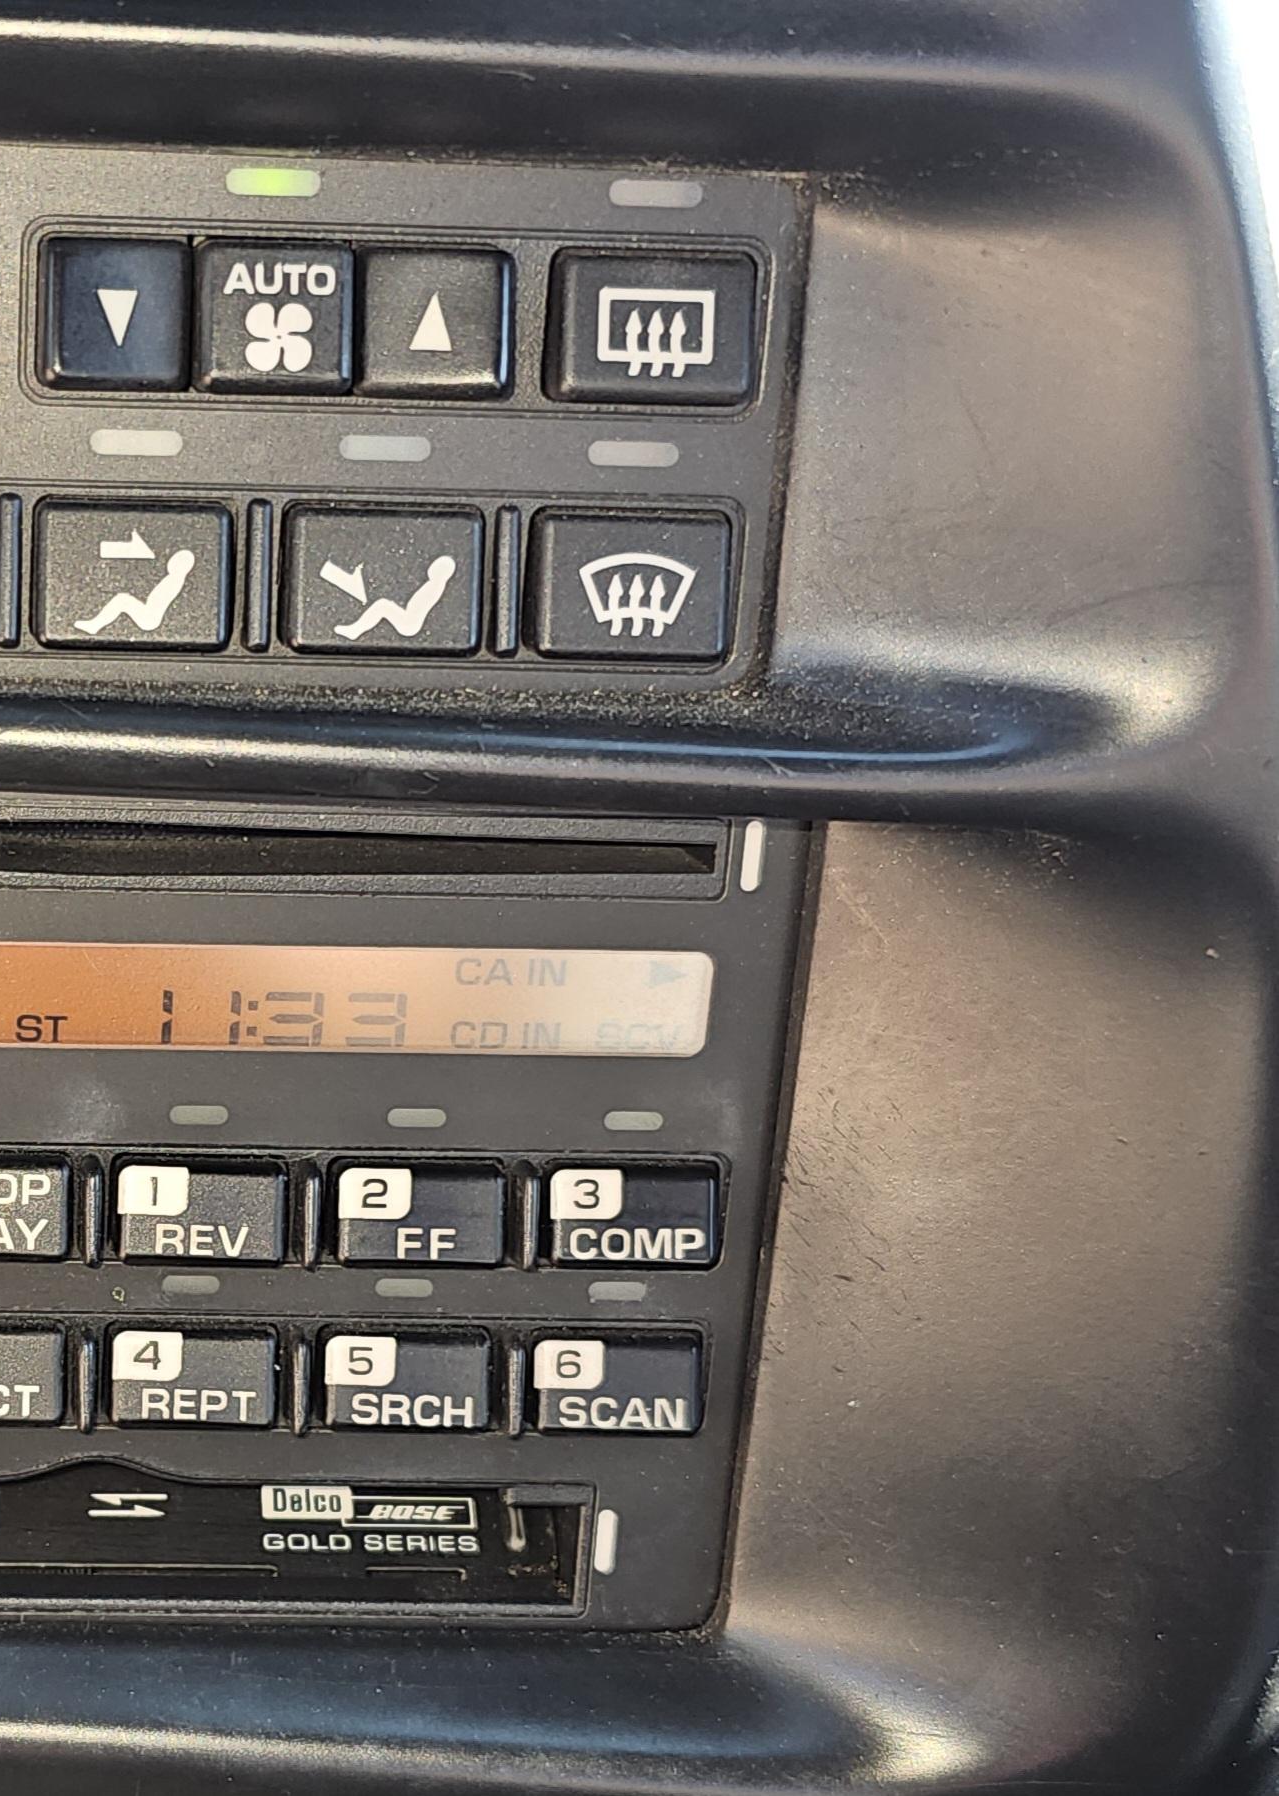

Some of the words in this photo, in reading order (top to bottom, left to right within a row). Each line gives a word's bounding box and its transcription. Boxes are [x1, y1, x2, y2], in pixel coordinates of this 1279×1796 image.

[223, 261, 336, 296] AUTO
[455, 958, 513, 986] CA
[528, 958, 568, 987] IN
[15, 1014, 69, 1043] ST
[161, 990, 408, 1047] 11:33
[450, 1021, 509, 1049] CD
[521, 1022, 562, 1050] IN
[149, 1175, 160, 1207] 1
[360, 1177, 390, 1209] 2
[572, 1178, 602, 1210] 3
[154, 1223, 249, 1257] REV
[396, 1227, 456, 1260] FF
[569, 1227, 707, 1261] COMP
[132, 1339, 162, 1371] 4
[347, 1345, 375, 1376] 5
[555, 1349, 583, 1380] 6
[140, 1388, 257, 1422] REPT
[350, 1393, 475, 1428] SRCH
[559, 1396, 687, 1430] SCAN
[272, 1487, 343, 1513] Delco
[356, 1504, 466, 1521] BOSE
[262, 1533, 353, 1551] GOLD
[363, 1534, 480, 1553] SERIES
